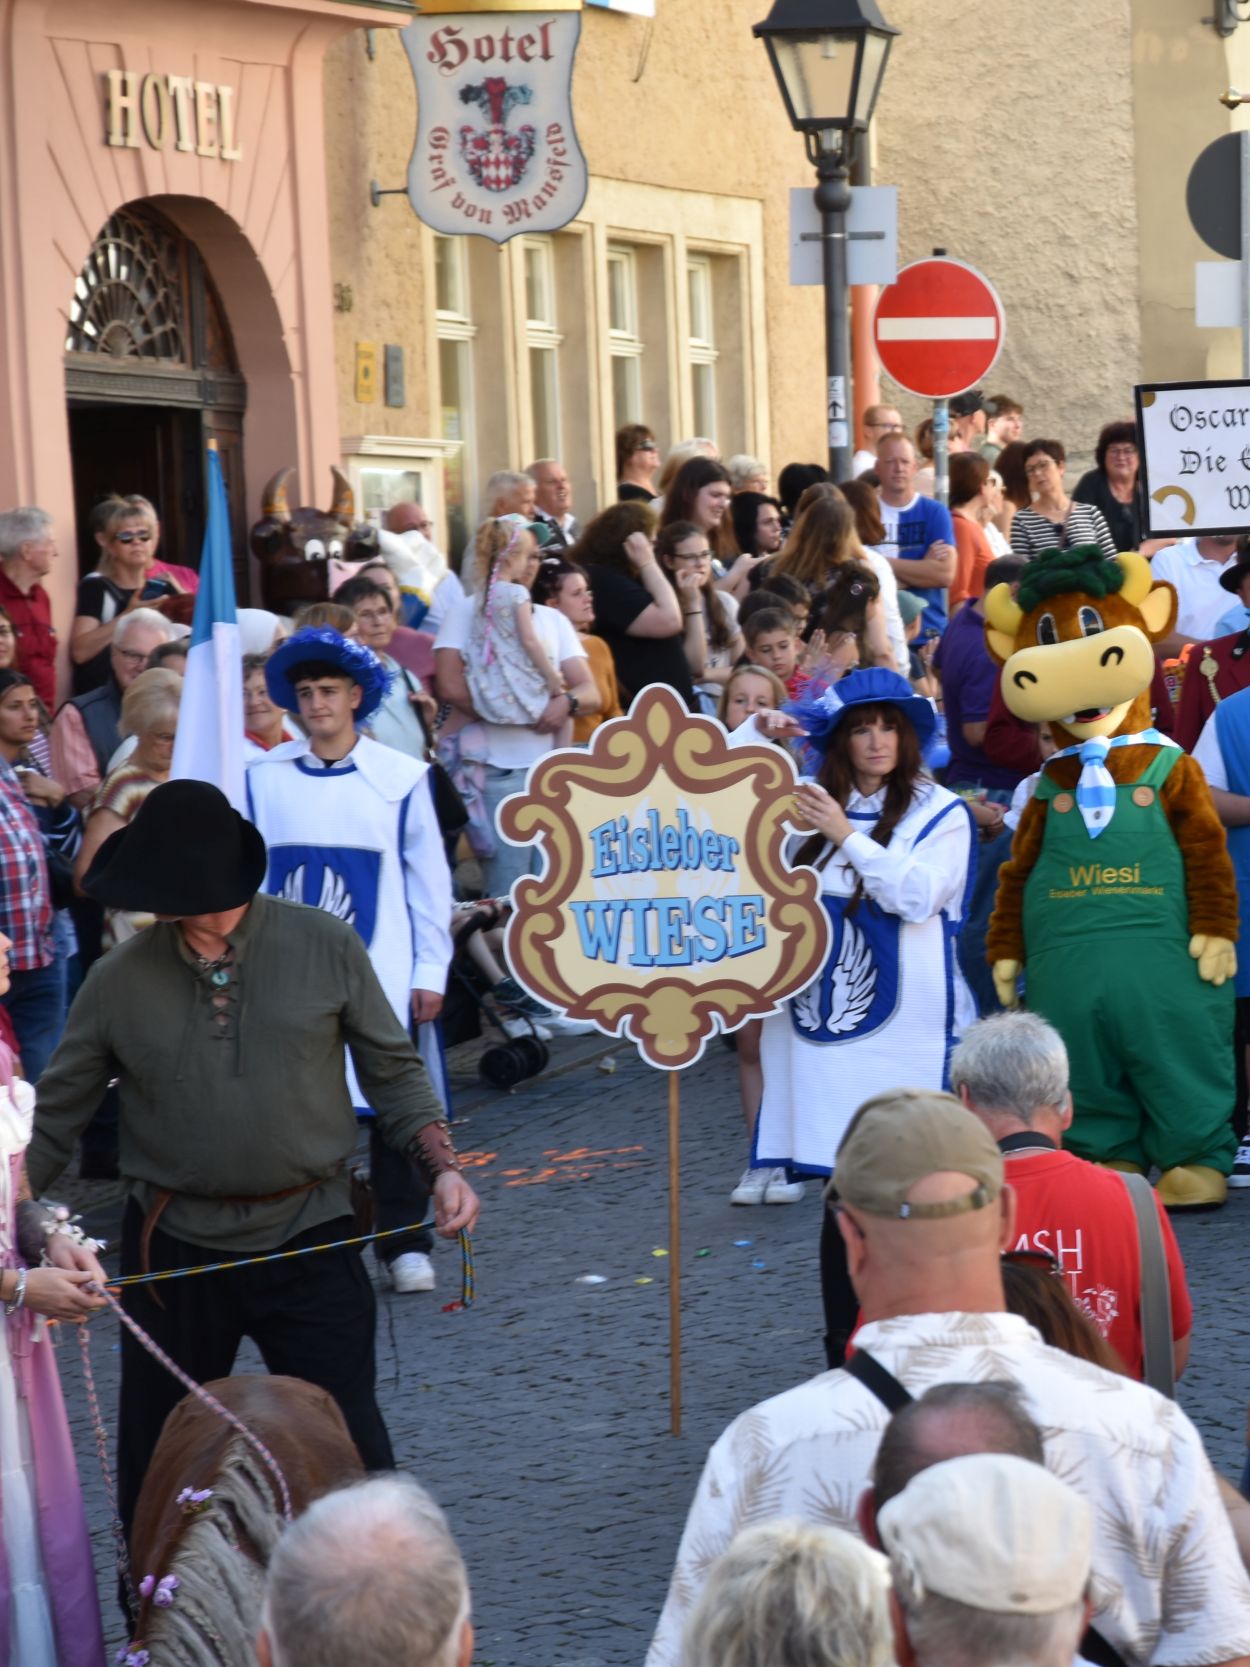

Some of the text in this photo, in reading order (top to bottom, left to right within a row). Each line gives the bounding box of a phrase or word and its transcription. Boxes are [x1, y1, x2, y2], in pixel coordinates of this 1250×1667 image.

[426, 18, 557, 77] Hotel
[106, 69, 243, 161] HOTEL
[428, 122, 573, 225] Graf von Mansfeld
[1169, 402, 1250, 432] Oscar
[1178, 446, 1227, 475] Die
[589, 808, 740, 879] Eisleber
[1069, 863, 1141, 887] Wiesi
[569, 894, 767, 968] WIESE
